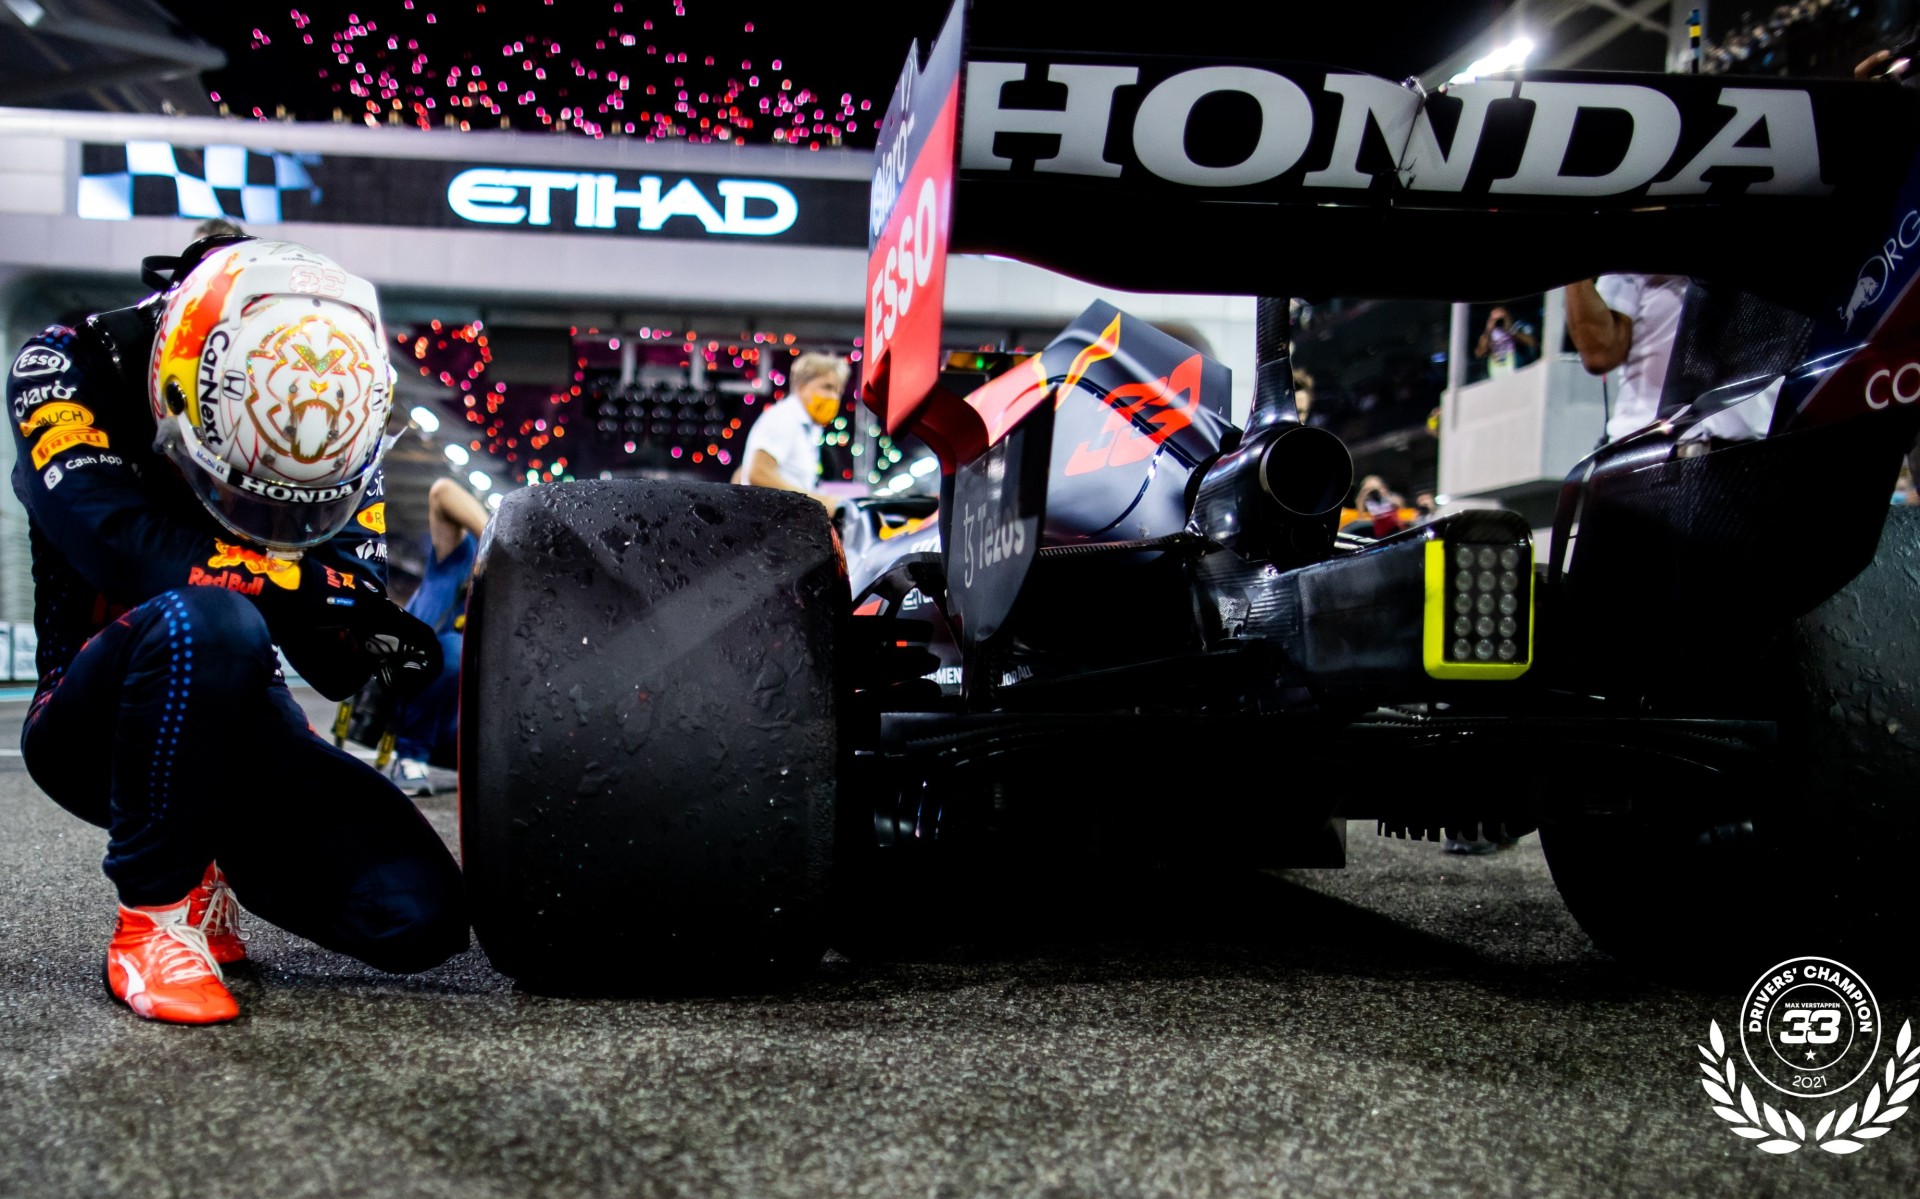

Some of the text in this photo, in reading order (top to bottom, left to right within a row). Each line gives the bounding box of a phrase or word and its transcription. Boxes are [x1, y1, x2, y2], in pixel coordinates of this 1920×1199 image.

[961, 62, 1833, 197] HONDA
[448, 168, 799, 236] ETIHAD
[871, 177, 937, 365] ESSO
[14, 379, 77, 418] claro
[199, 329, 230, 446] CarNext
[65, 454, 123, 470] Cash App
[239, 474, 355, 503] HONDA
[976, 502, 1026, 570] Tezos
[187, 566, 266, 597] Red Bull
